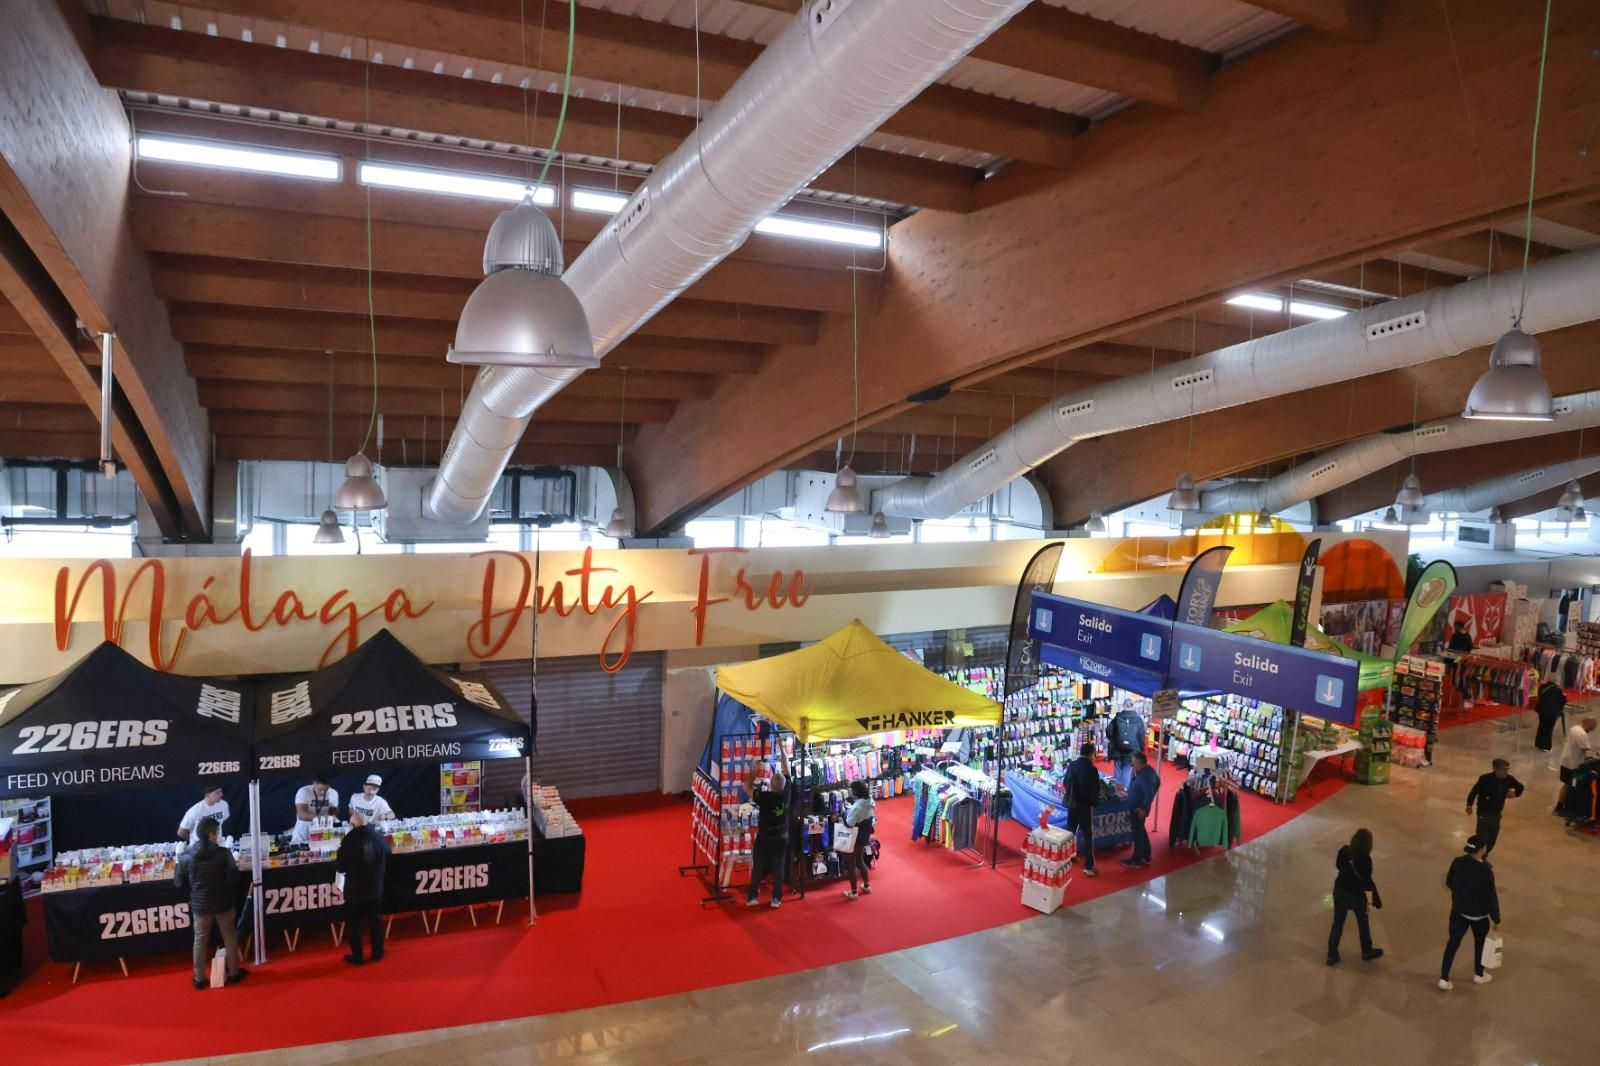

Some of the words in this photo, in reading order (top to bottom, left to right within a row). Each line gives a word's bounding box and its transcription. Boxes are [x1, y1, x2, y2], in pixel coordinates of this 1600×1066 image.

[55, 547, 434, 672] Málaga
[466, 545, 653, 673] Duty
[688, 547, 815, 647] Free
[1078, 614, 1113, 633] Salida
[1077, 629, 1093, 645] Exit
[1234, 651, 1279, 675] Salida
[1233, 669, 1254, 687] Exit
[331, 702, 458, 737] 226ERS
[883, 710, 956, 730] HANKER
[12, 719, 169, 755] 226ERS
[259, 754, 301, 770] 226ERS
[332, 748, 366, 765] FEED
[368, 745, 404, 762] YOUR
[407, 741, 461, 759] DREAMS
[7, 772, 48, 790] FEED
[52, 768, 95, 787] YOUR
[100, 764, 165, 783] DREAMS
[198, 761, 240, 775] 226ERS
[415, 863, 489, 895] 226ERS
[264, 881, 345, 915] 226ERS
[99, 902, 191, 940] 226ERS
